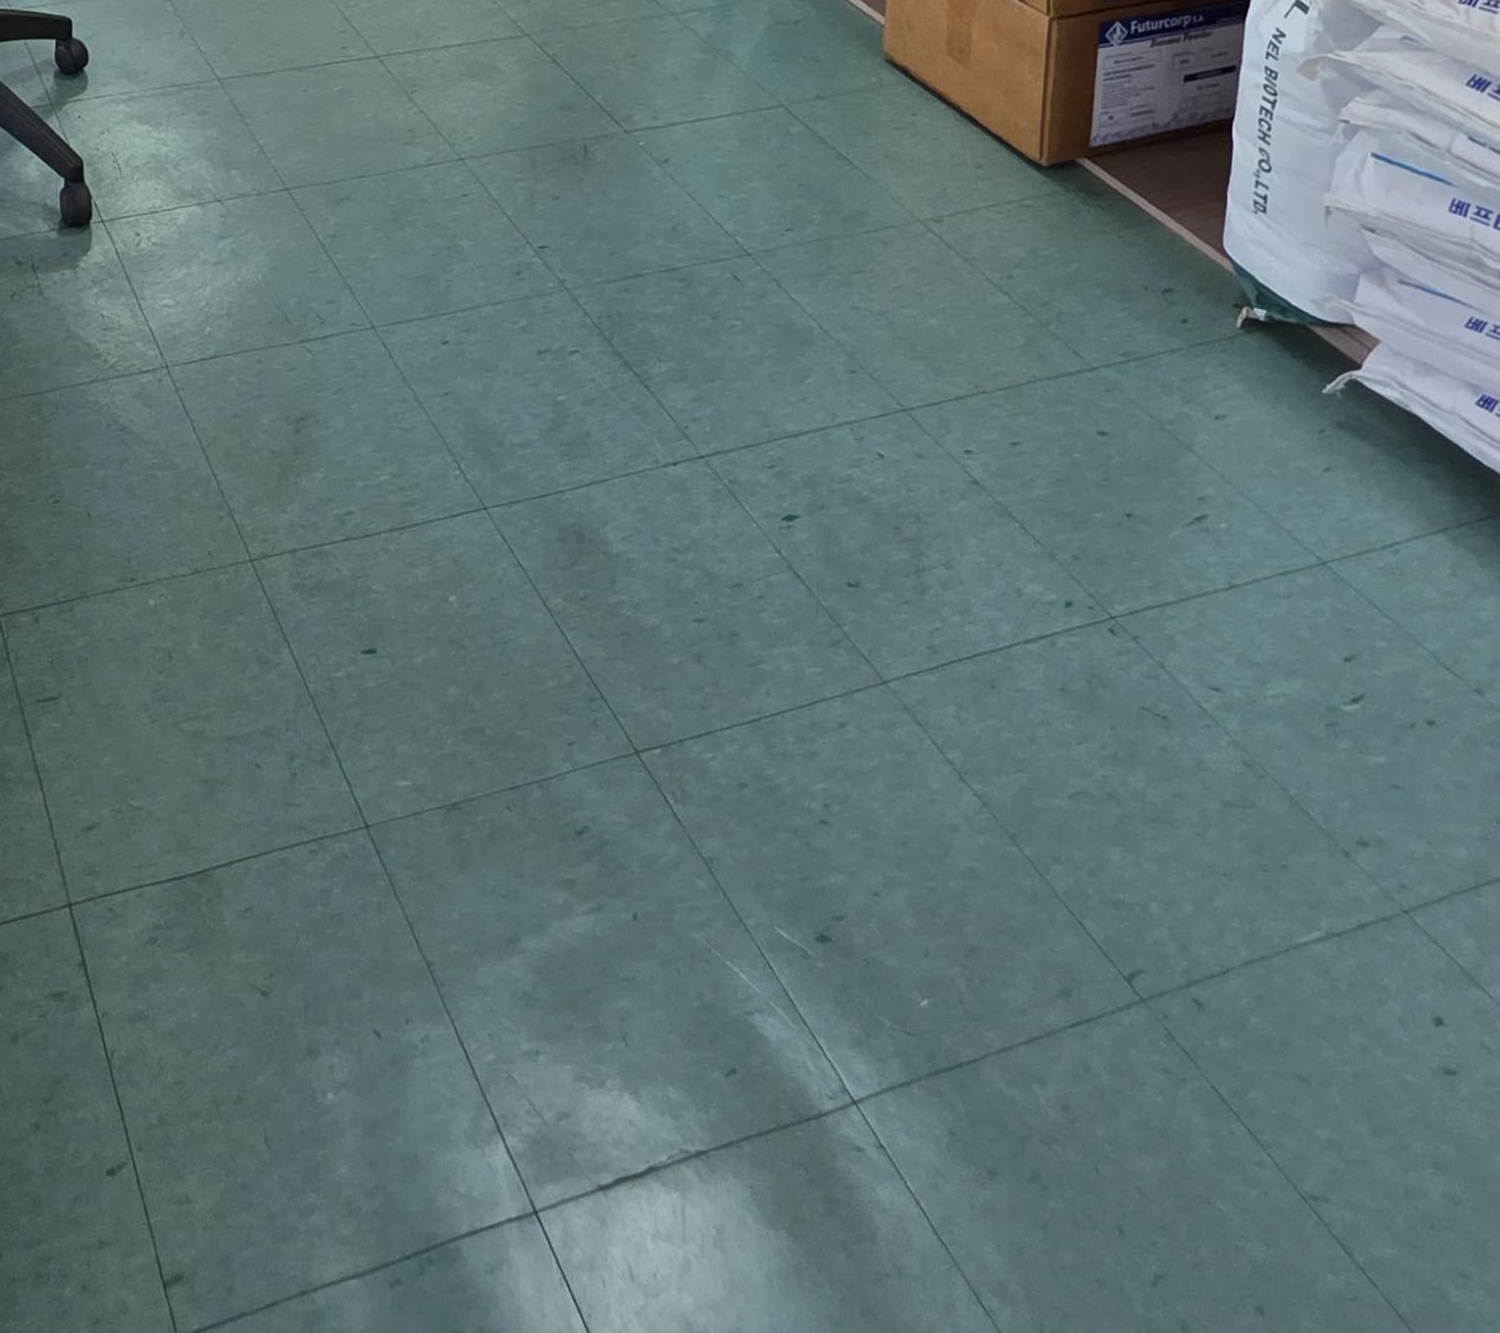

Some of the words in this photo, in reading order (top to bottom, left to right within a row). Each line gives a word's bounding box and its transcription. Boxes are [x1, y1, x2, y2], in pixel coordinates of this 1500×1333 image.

[1130, 14, 1192, 34] Futurcorp
[1265, 27, 1287, 62] NEL
[1257, 65, 1279, 147] BIOTECH
